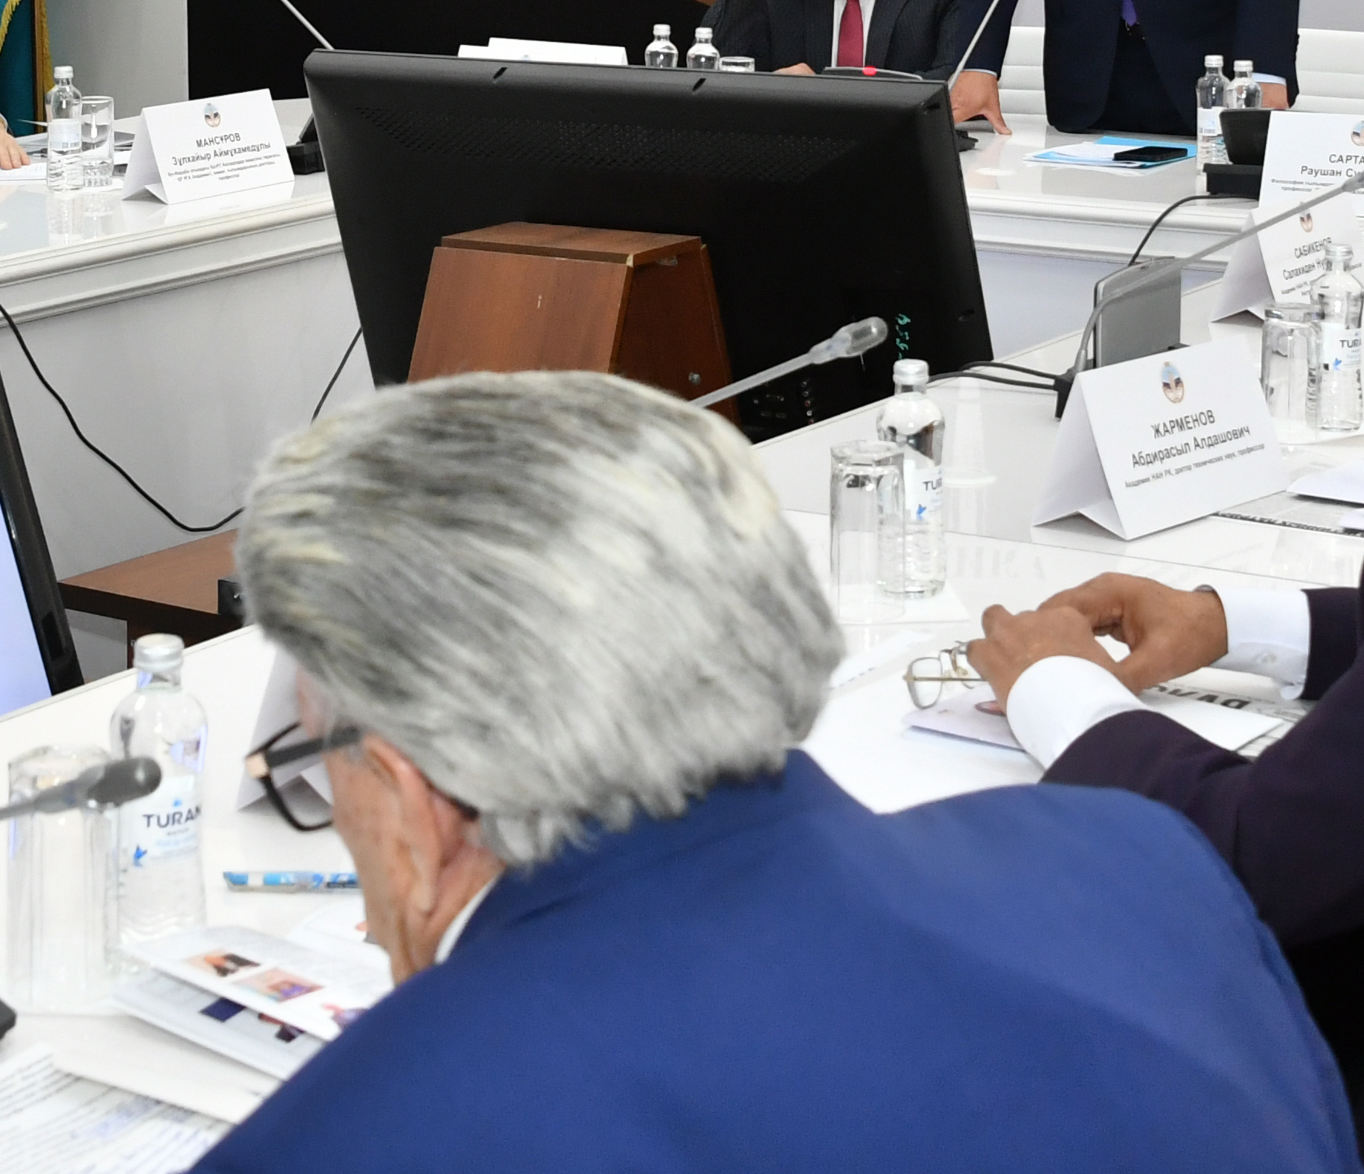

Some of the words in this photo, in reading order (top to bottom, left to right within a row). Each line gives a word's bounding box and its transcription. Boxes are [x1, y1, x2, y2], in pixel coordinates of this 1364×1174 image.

[1300, 165, 1342, 178] Раушан
[1150, 409, 1216, 439] ЖАРМЕНОВ
[1131, 441, 1192, 469] Абдирасыл
[1193, 425, 1251, 452] Алдашович
